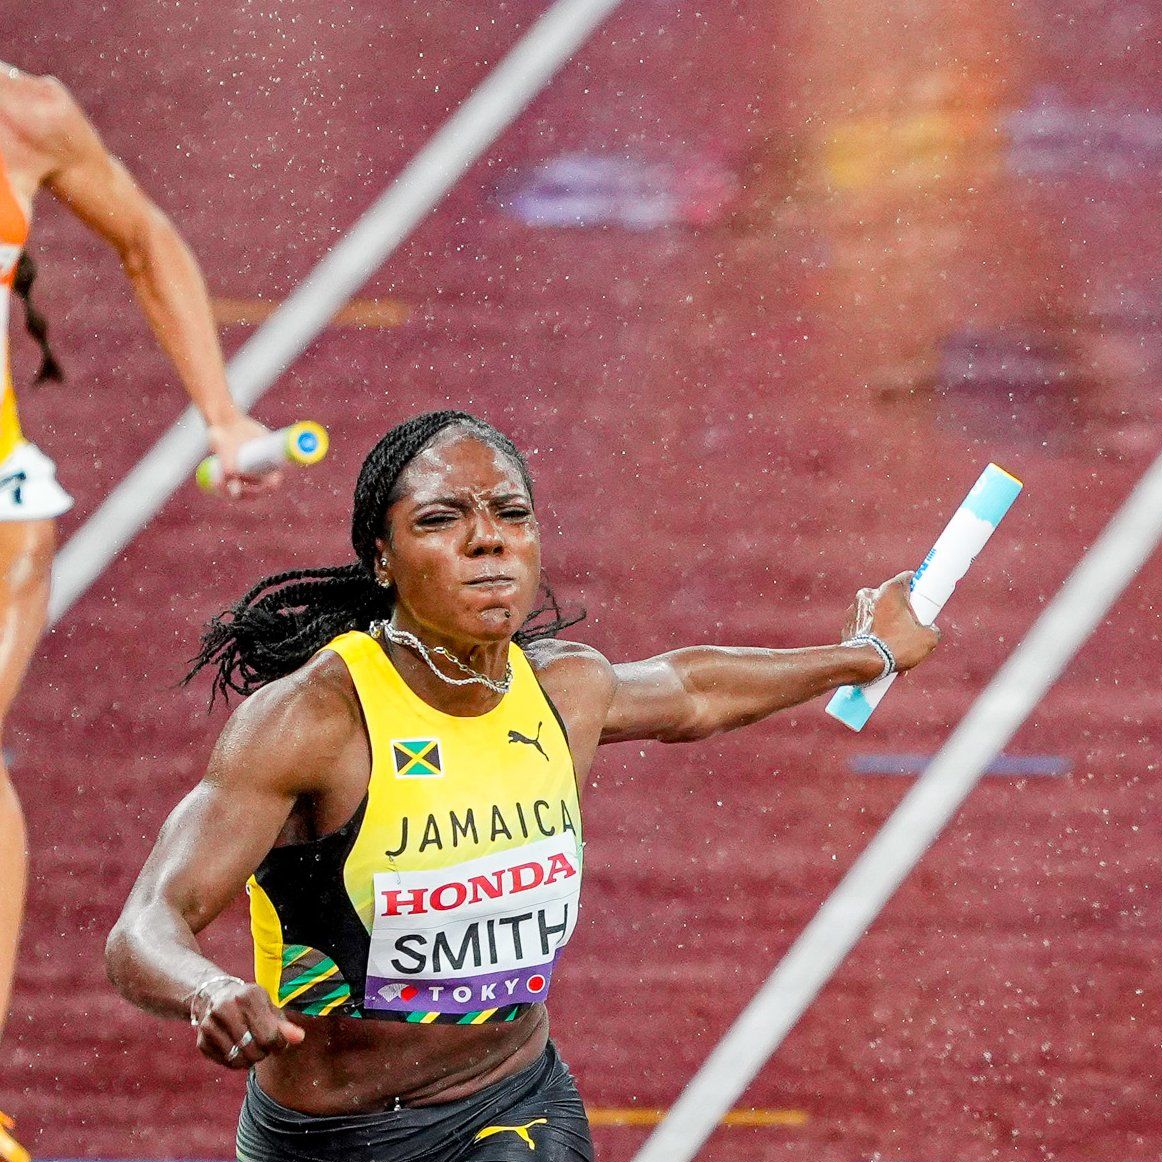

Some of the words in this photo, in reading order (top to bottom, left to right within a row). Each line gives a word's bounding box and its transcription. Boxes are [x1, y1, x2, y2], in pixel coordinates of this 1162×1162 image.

[385, 799, 576, 857] JAMAICA
[381, 852, 577, 917] HONDA
[391, 903, 569, 975] SMITH
